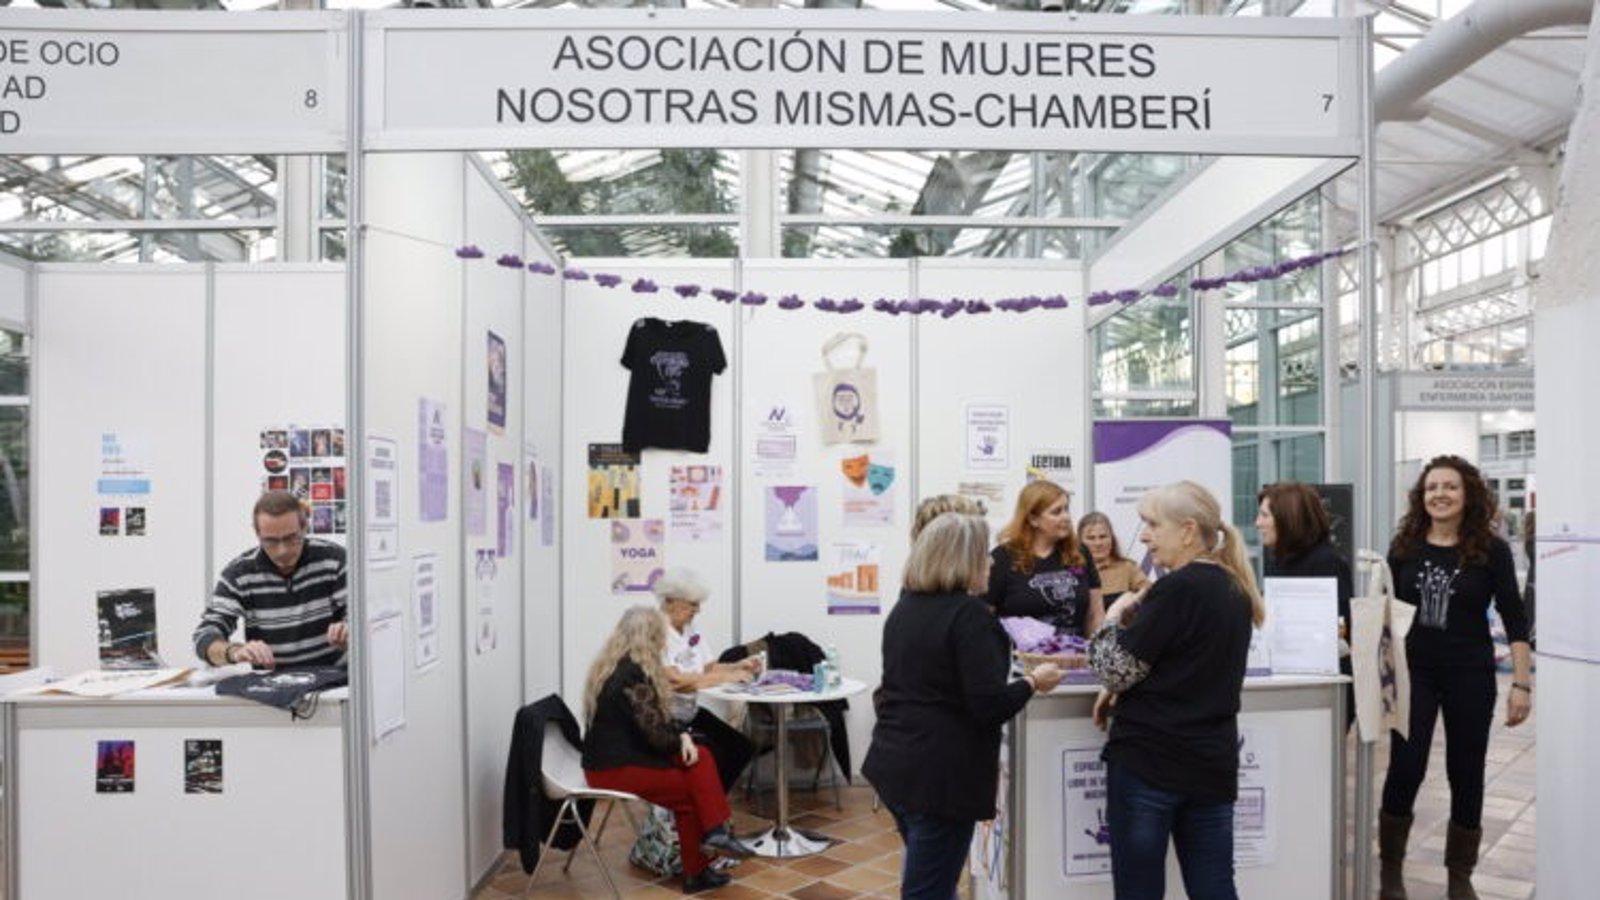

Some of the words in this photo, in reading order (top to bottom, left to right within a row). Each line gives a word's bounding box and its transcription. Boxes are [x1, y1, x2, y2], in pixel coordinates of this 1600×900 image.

[40, 40, 119, 66] OCIO
[553, 30, 845, 73] ASOCIACIÓN
[864, 40, 924, 74] DE
[942, 41, 1156, 79] MUJERES
[3, 75, 46, 99] AD
[305, 89, 318, 108] 8
[1321, 94, 1334, 113] 7
[497, 88, 757, 124] NOSOTRAS
[776, 88, 1211, 131] MISMAS-CHAMBERÍ
[1032, 454, 1071, 469] LECTURA
[620, 547, 656, 559] YOGA
